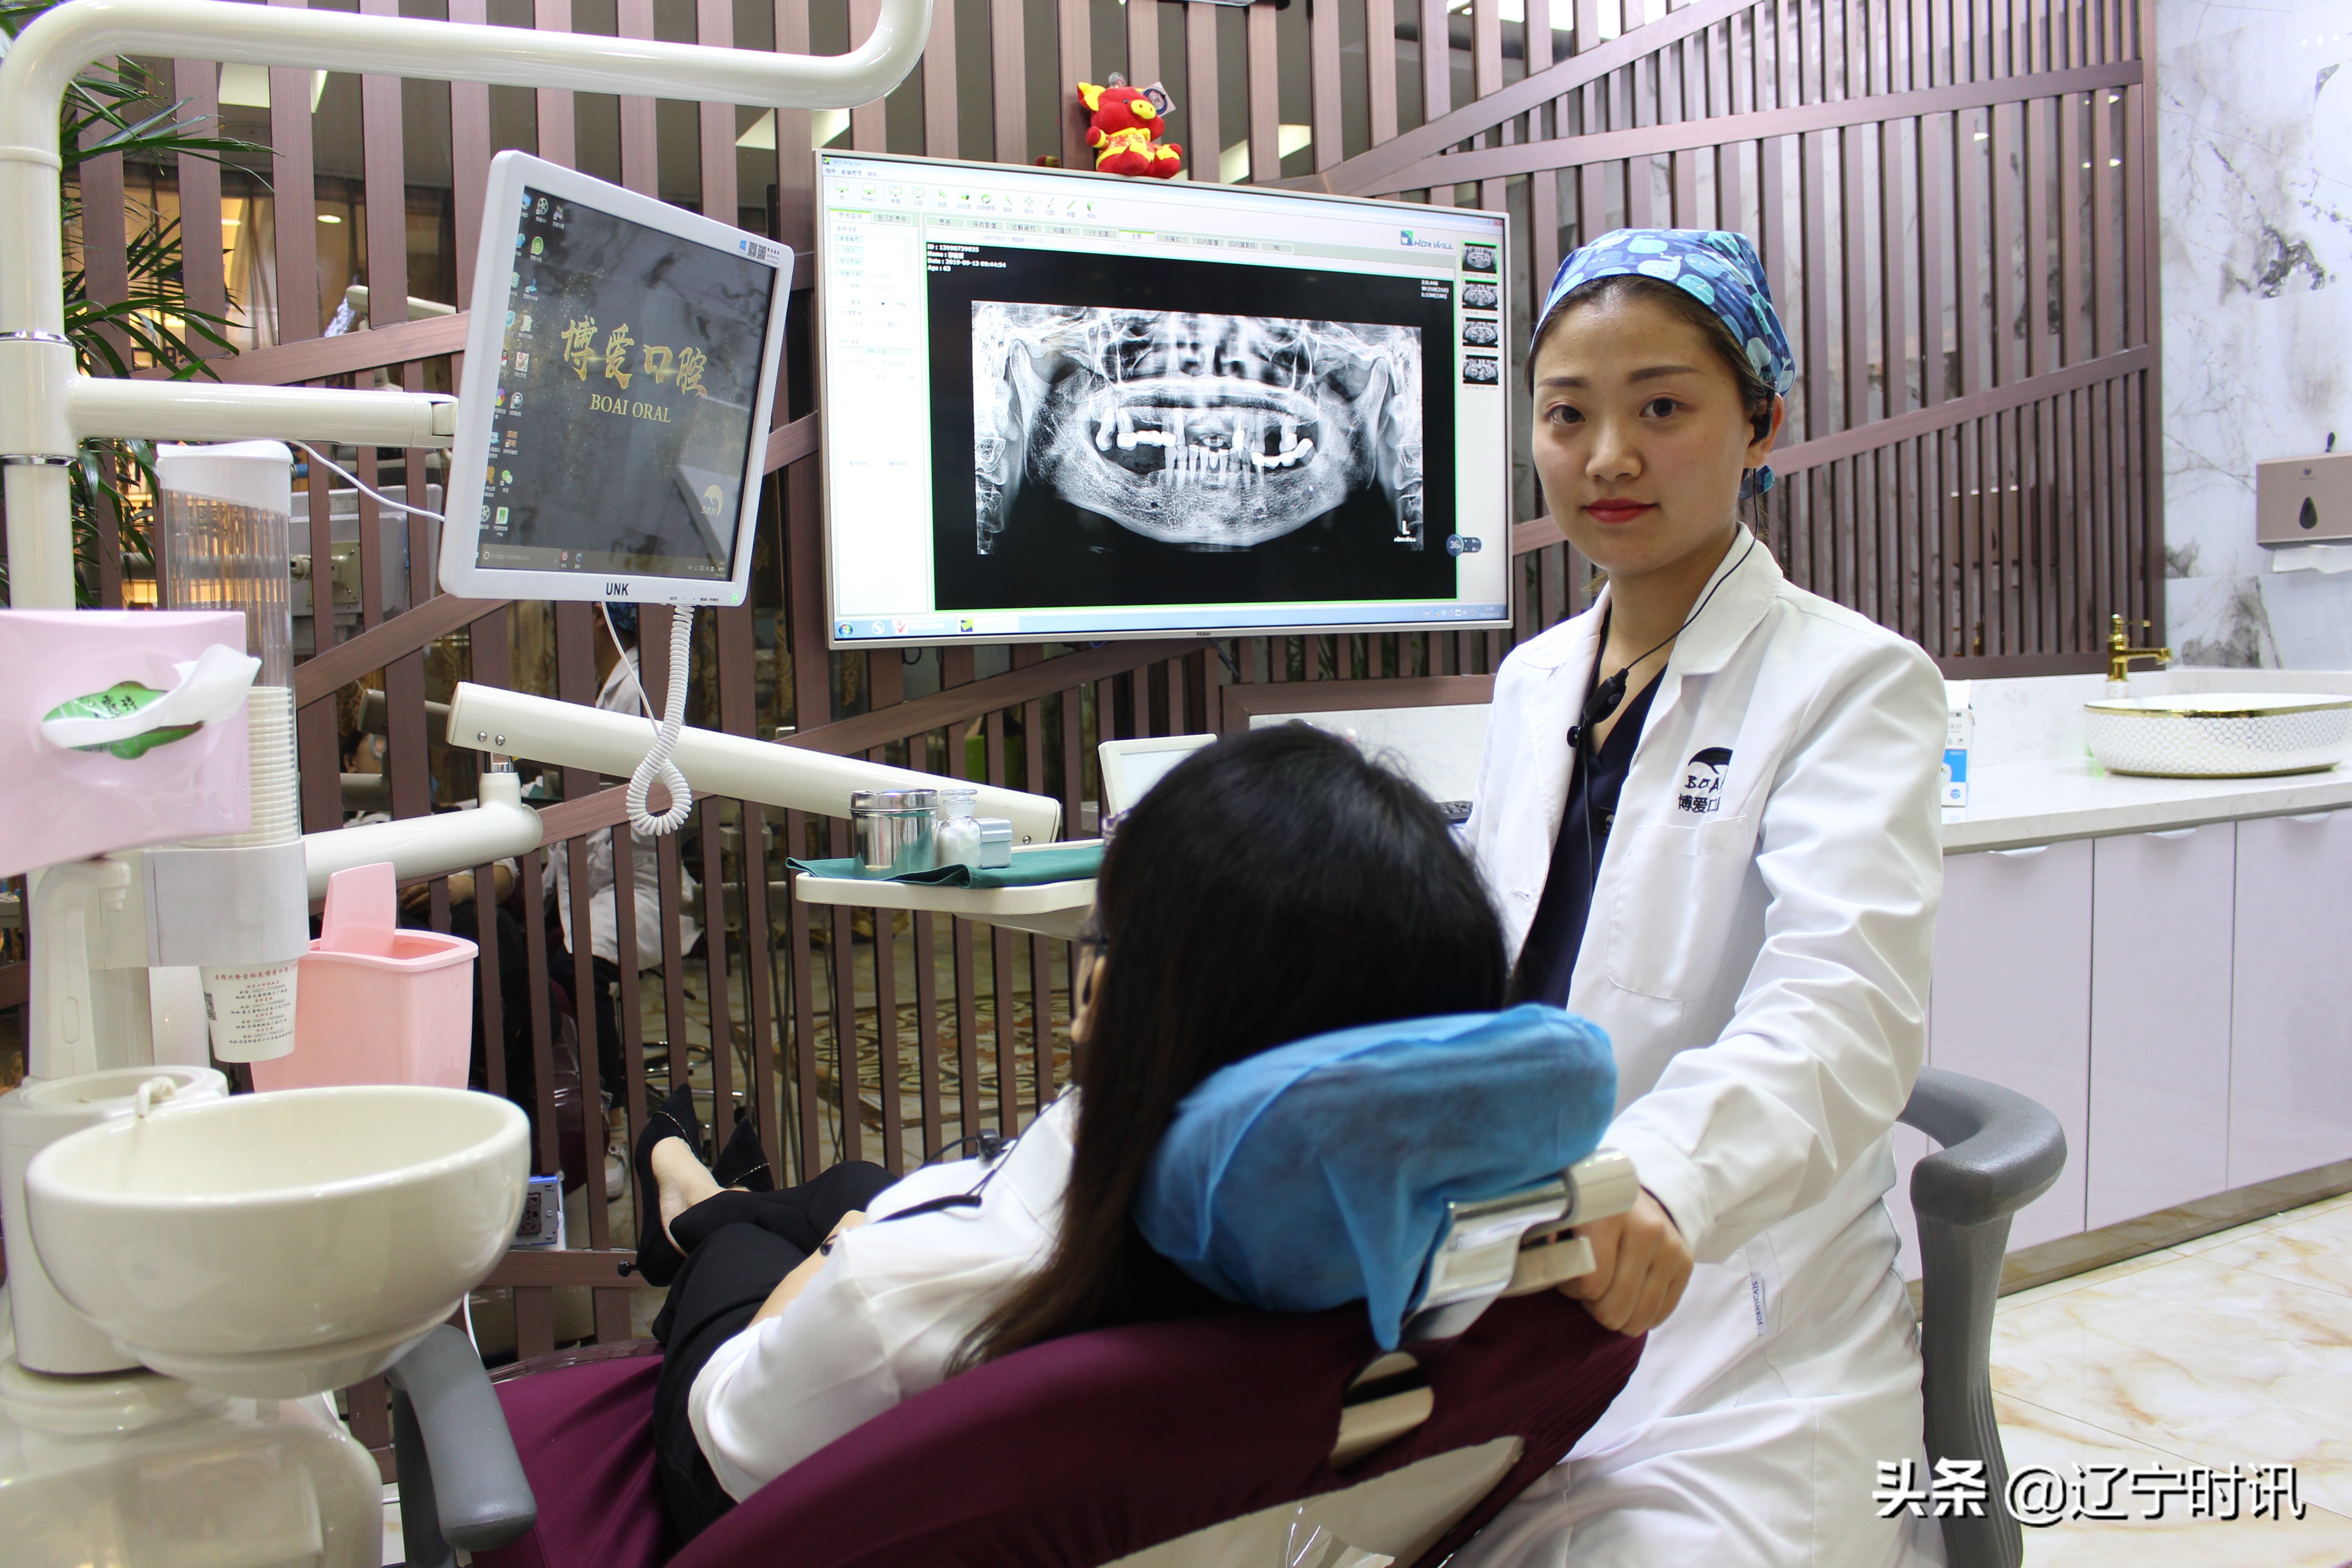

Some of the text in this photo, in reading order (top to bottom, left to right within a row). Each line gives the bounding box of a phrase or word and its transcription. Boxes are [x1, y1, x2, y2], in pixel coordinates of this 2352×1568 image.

[590, 393, 671, 423] BOAI ORAL
[1402, 520, 1411, 535] L
[606, 582, 629, 596] UNK
[1678, 793, 1721, 813] 博爱口
[1752, 1280, 1764, 1325] FORNYCAIS
